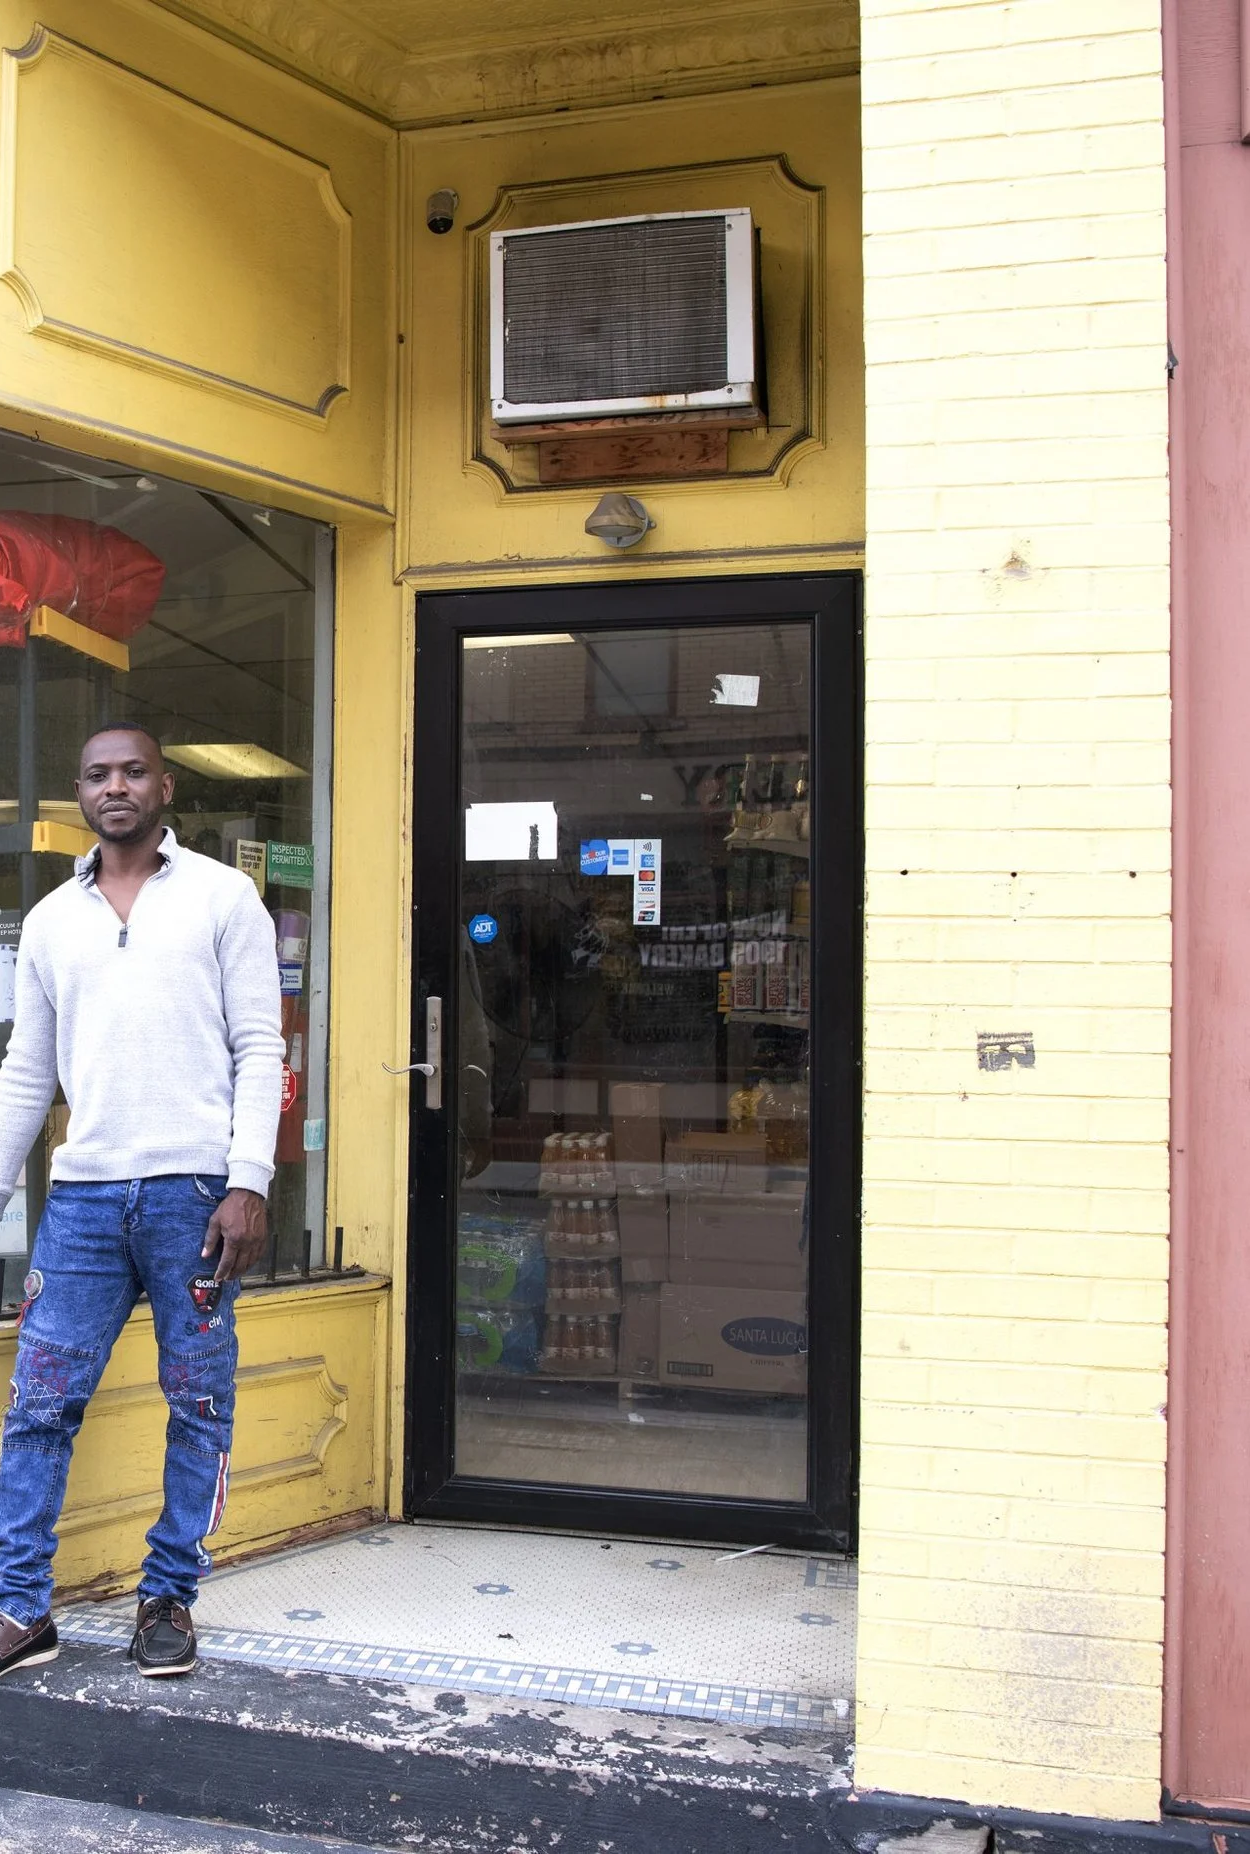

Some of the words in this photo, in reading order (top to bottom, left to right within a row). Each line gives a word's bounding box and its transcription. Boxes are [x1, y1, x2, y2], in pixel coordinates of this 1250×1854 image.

[271, 844, 306, 856] INSPECTED
[271, 854, 305, 866] PERMITTED
[473, 921, 493, 933] ADT
[729, 1327, 768, 1343] SANTA
[770, 1329, 807, 1346] LUCIA
